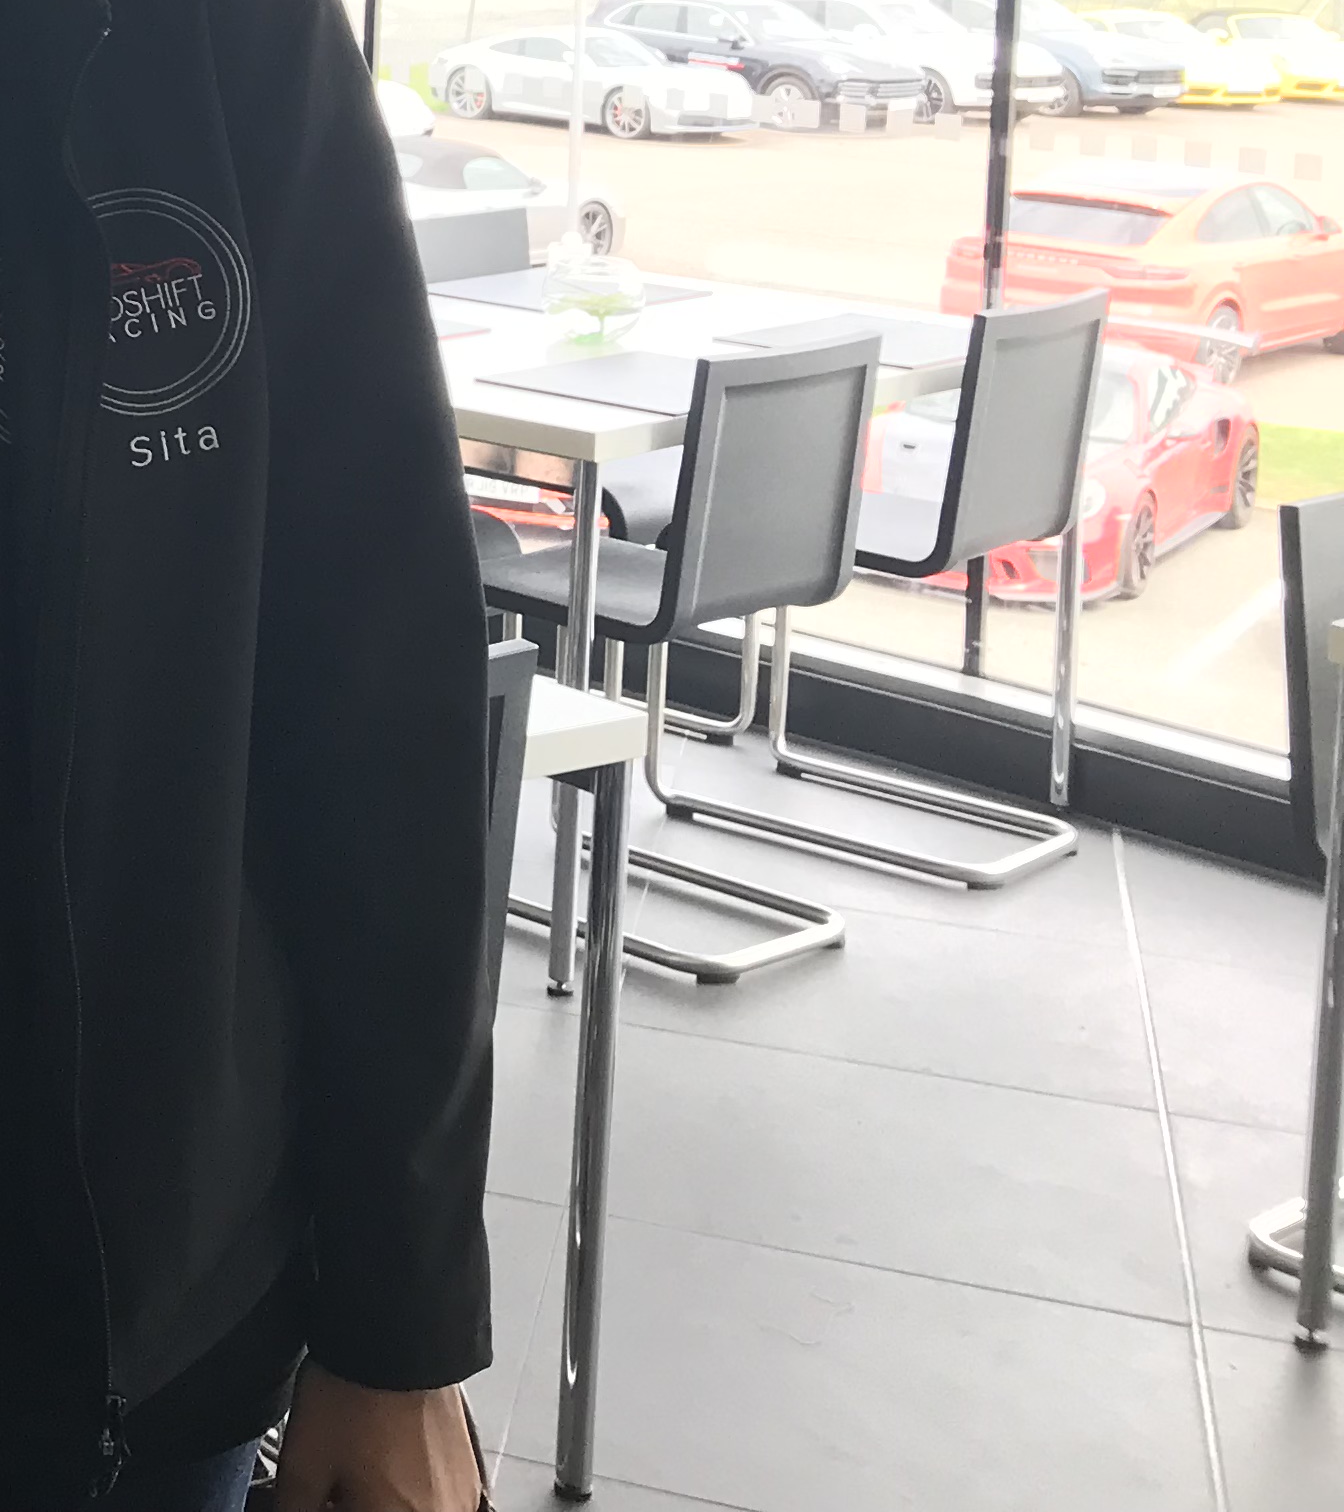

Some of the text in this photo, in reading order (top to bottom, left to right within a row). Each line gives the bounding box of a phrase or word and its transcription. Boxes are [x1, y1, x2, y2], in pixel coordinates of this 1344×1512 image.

[111, 273, 203, 323] DSHIFT
[109, 300, 217, 343] CING
[129, 425, 220, 468] Sita
